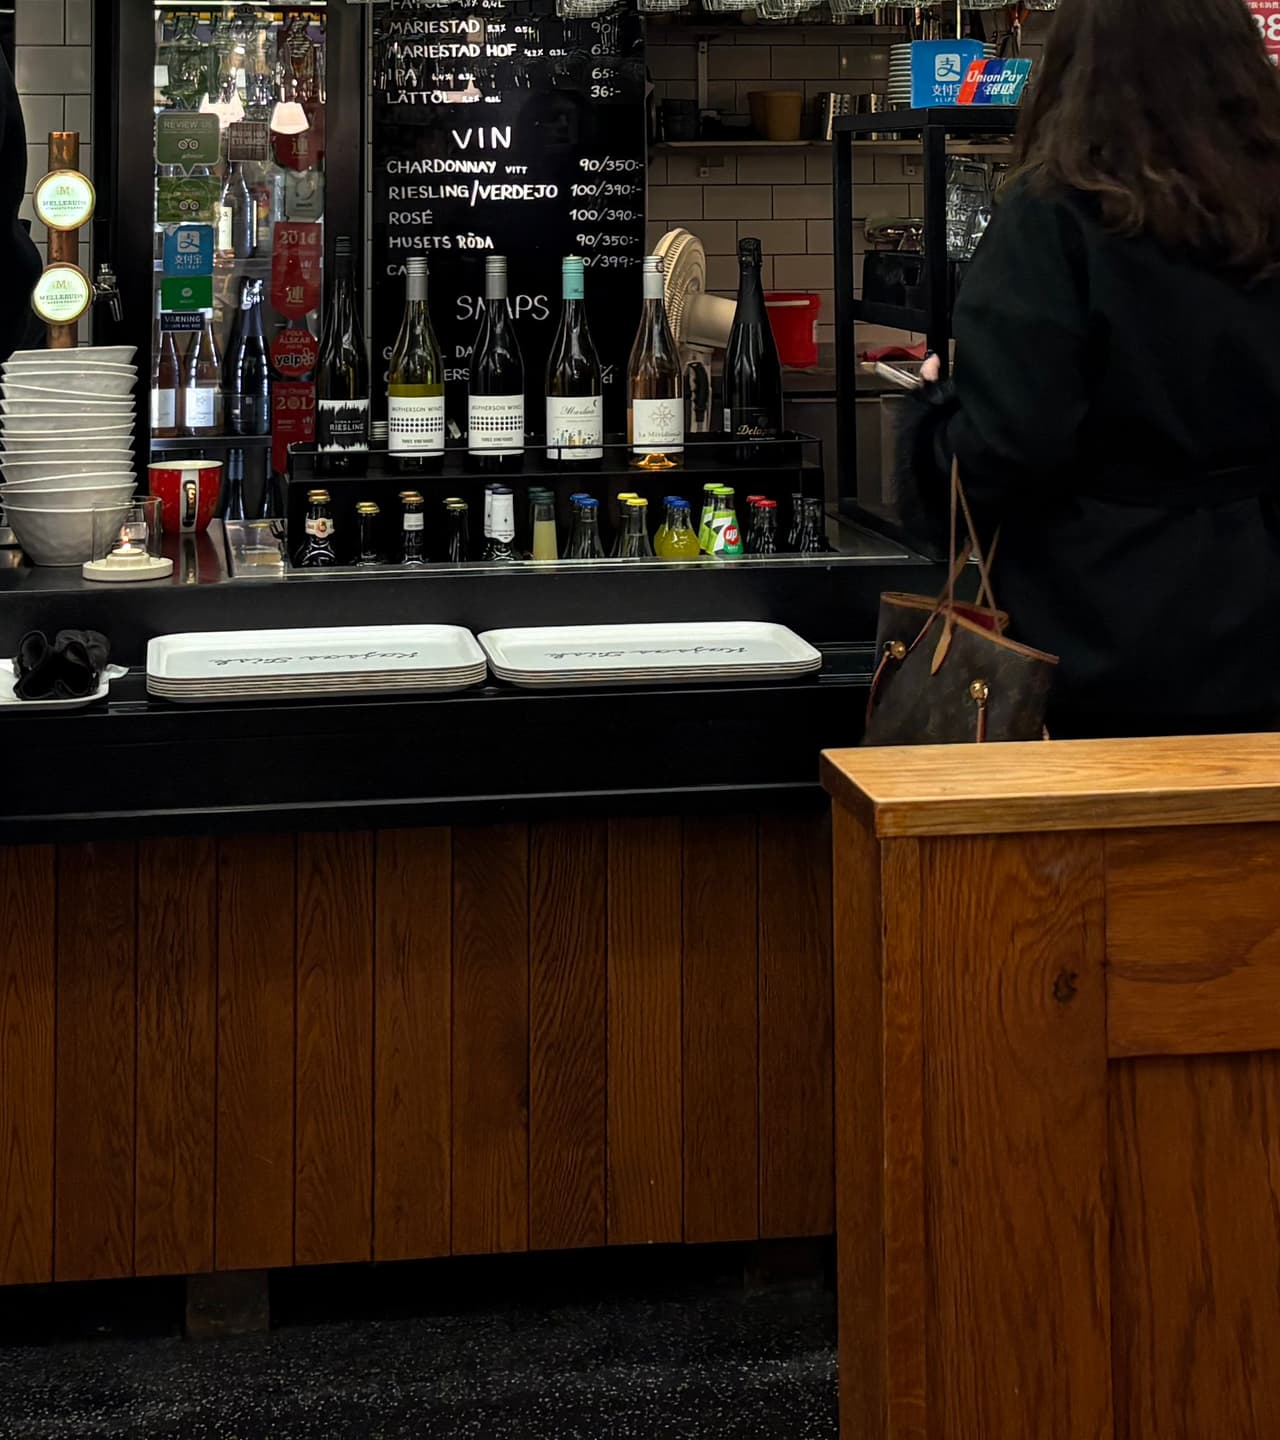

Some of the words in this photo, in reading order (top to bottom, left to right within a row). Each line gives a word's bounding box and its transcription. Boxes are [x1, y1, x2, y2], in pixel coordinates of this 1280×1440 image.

[389, 20, 480, 34] MARIESTAD
[388, 44, 481, 58] MARIESTAD
[486, 44, 517, 57] HOF
[967, 70, 1023, 85] UnionPay
[386, 90, 450, 104] LÄTTÖL
[452, 126, 512, 149] VIN
[387, 159, 496, 174] CHARDONNAY
[505, 165, 528, 175] VITT
[388, 210, 433, 225] ROSÉ
[388, 236, 451, 249] HUSETS
[456, 232, 494, 249] RÖDA
[276, 355, 302, 366] yelp
